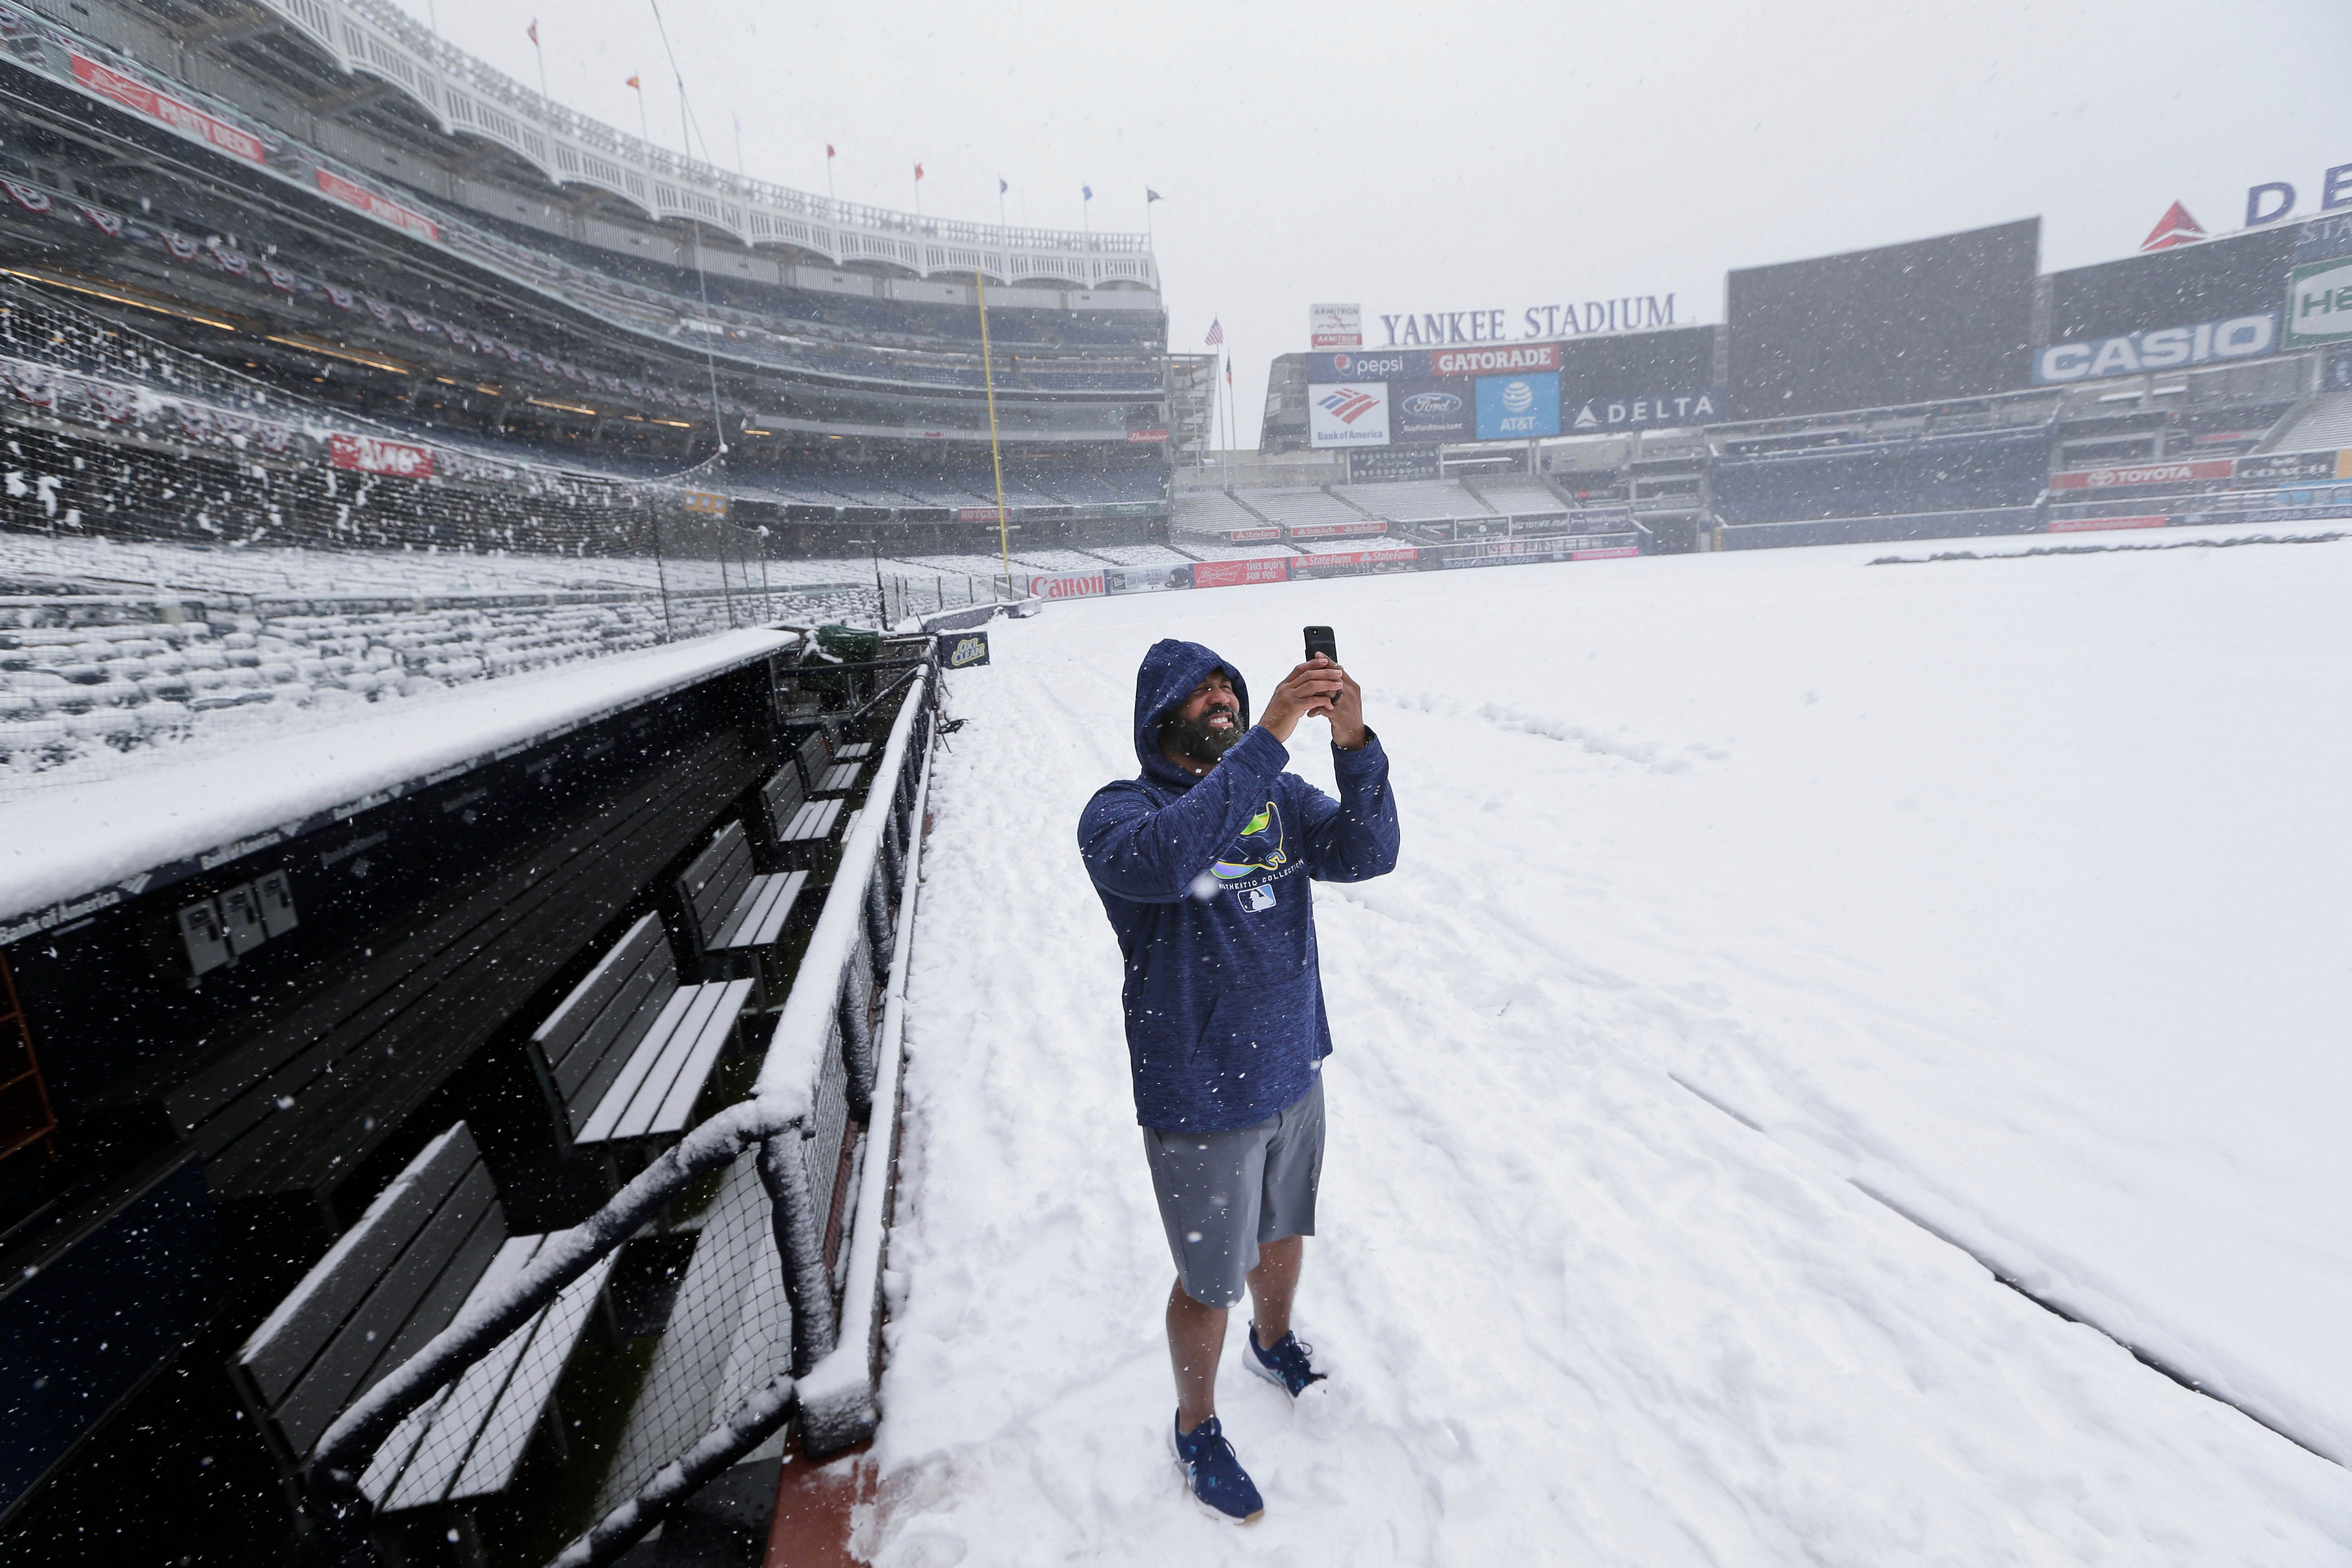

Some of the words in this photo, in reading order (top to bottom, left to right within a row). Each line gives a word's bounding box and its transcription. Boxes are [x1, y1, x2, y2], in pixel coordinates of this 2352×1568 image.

[1381, 309, 1505, 346] YANKEE
[1525, 293, 1677, 339] STADIUM
[2042, 315, 2274, 381] CASIO
[1357, 356, 1403, 376] pepsi
[1439, 347, 1552, 372] GATORADE
[1413, 393, 1449, 412] Ford
[1607, 395, 1715, 424] DELTA
[1500, 416, 1536, 431] AT&T
[1318, 431, 1339, 441] Bank
[1339, 431, 1348, 440] of
[1348, 430, 1383, 440] America
[2118, 466, 2192, 484] TOYOTA
[1030, 575, 1104, 599] Canon
[954, 646, 983, 664] CLEAN
[959, 640, 976, 652] OXI
[1262, 858, 1304, 883] COLLECTION
